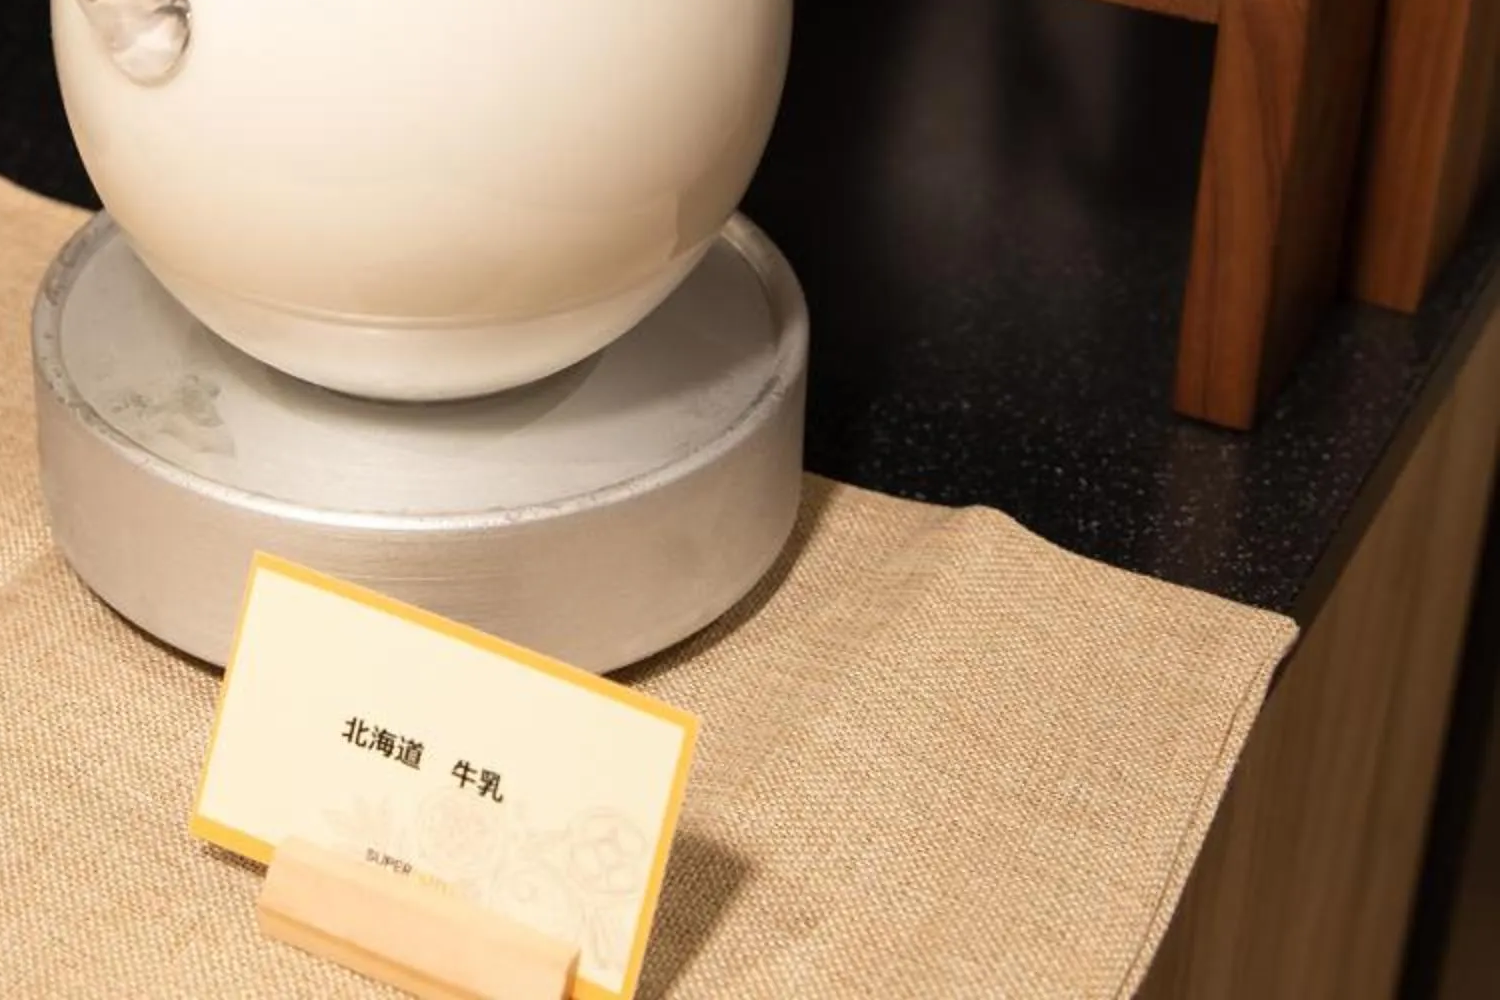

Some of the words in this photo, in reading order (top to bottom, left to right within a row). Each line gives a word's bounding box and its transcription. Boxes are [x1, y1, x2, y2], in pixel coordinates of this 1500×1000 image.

[341, 716, 424, 771] 北海道
[451, 759, 505, 804] 牛乳
[365, 847, 414, 877] SUPER
